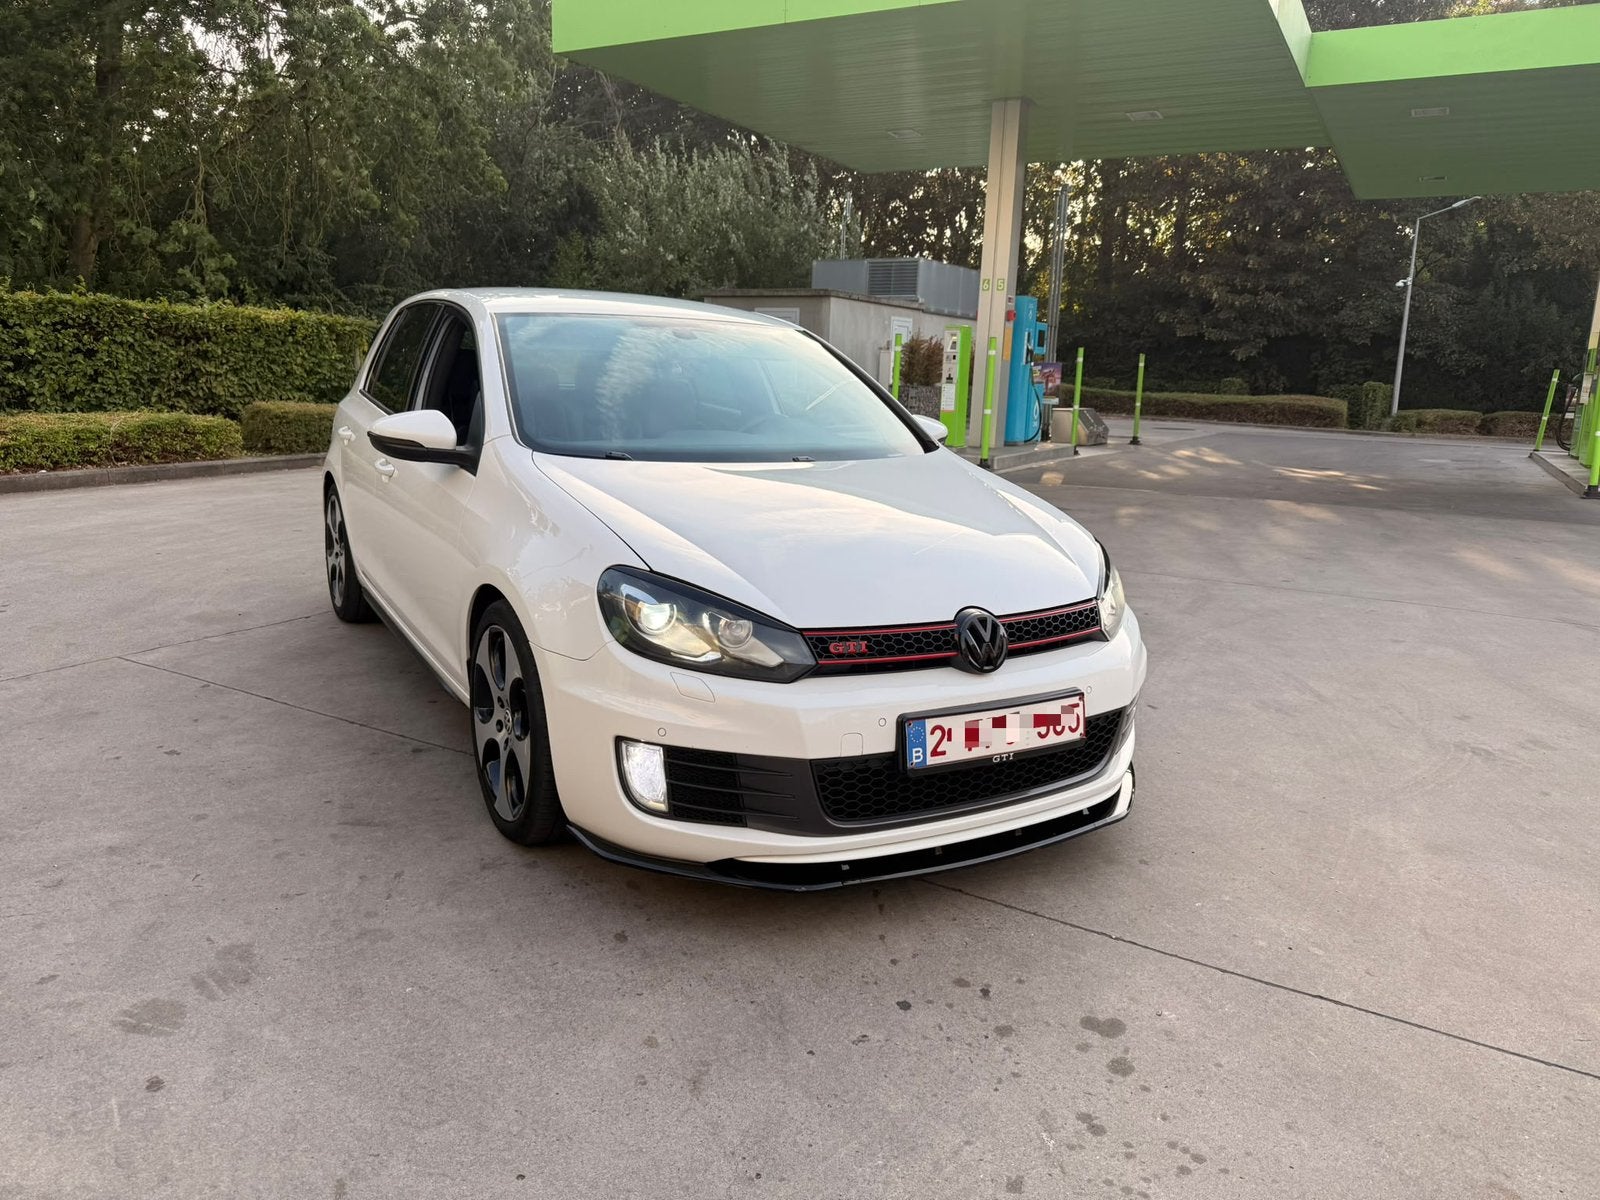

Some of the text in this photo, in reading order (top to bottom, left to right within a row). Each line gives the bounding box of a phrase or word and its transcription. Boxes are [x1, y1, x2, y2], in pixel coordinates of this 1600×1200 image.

[829, 641, 868, 655] GTI
[912, 747, 924, 763] B
[992, 752, 1014, 763] GTI
